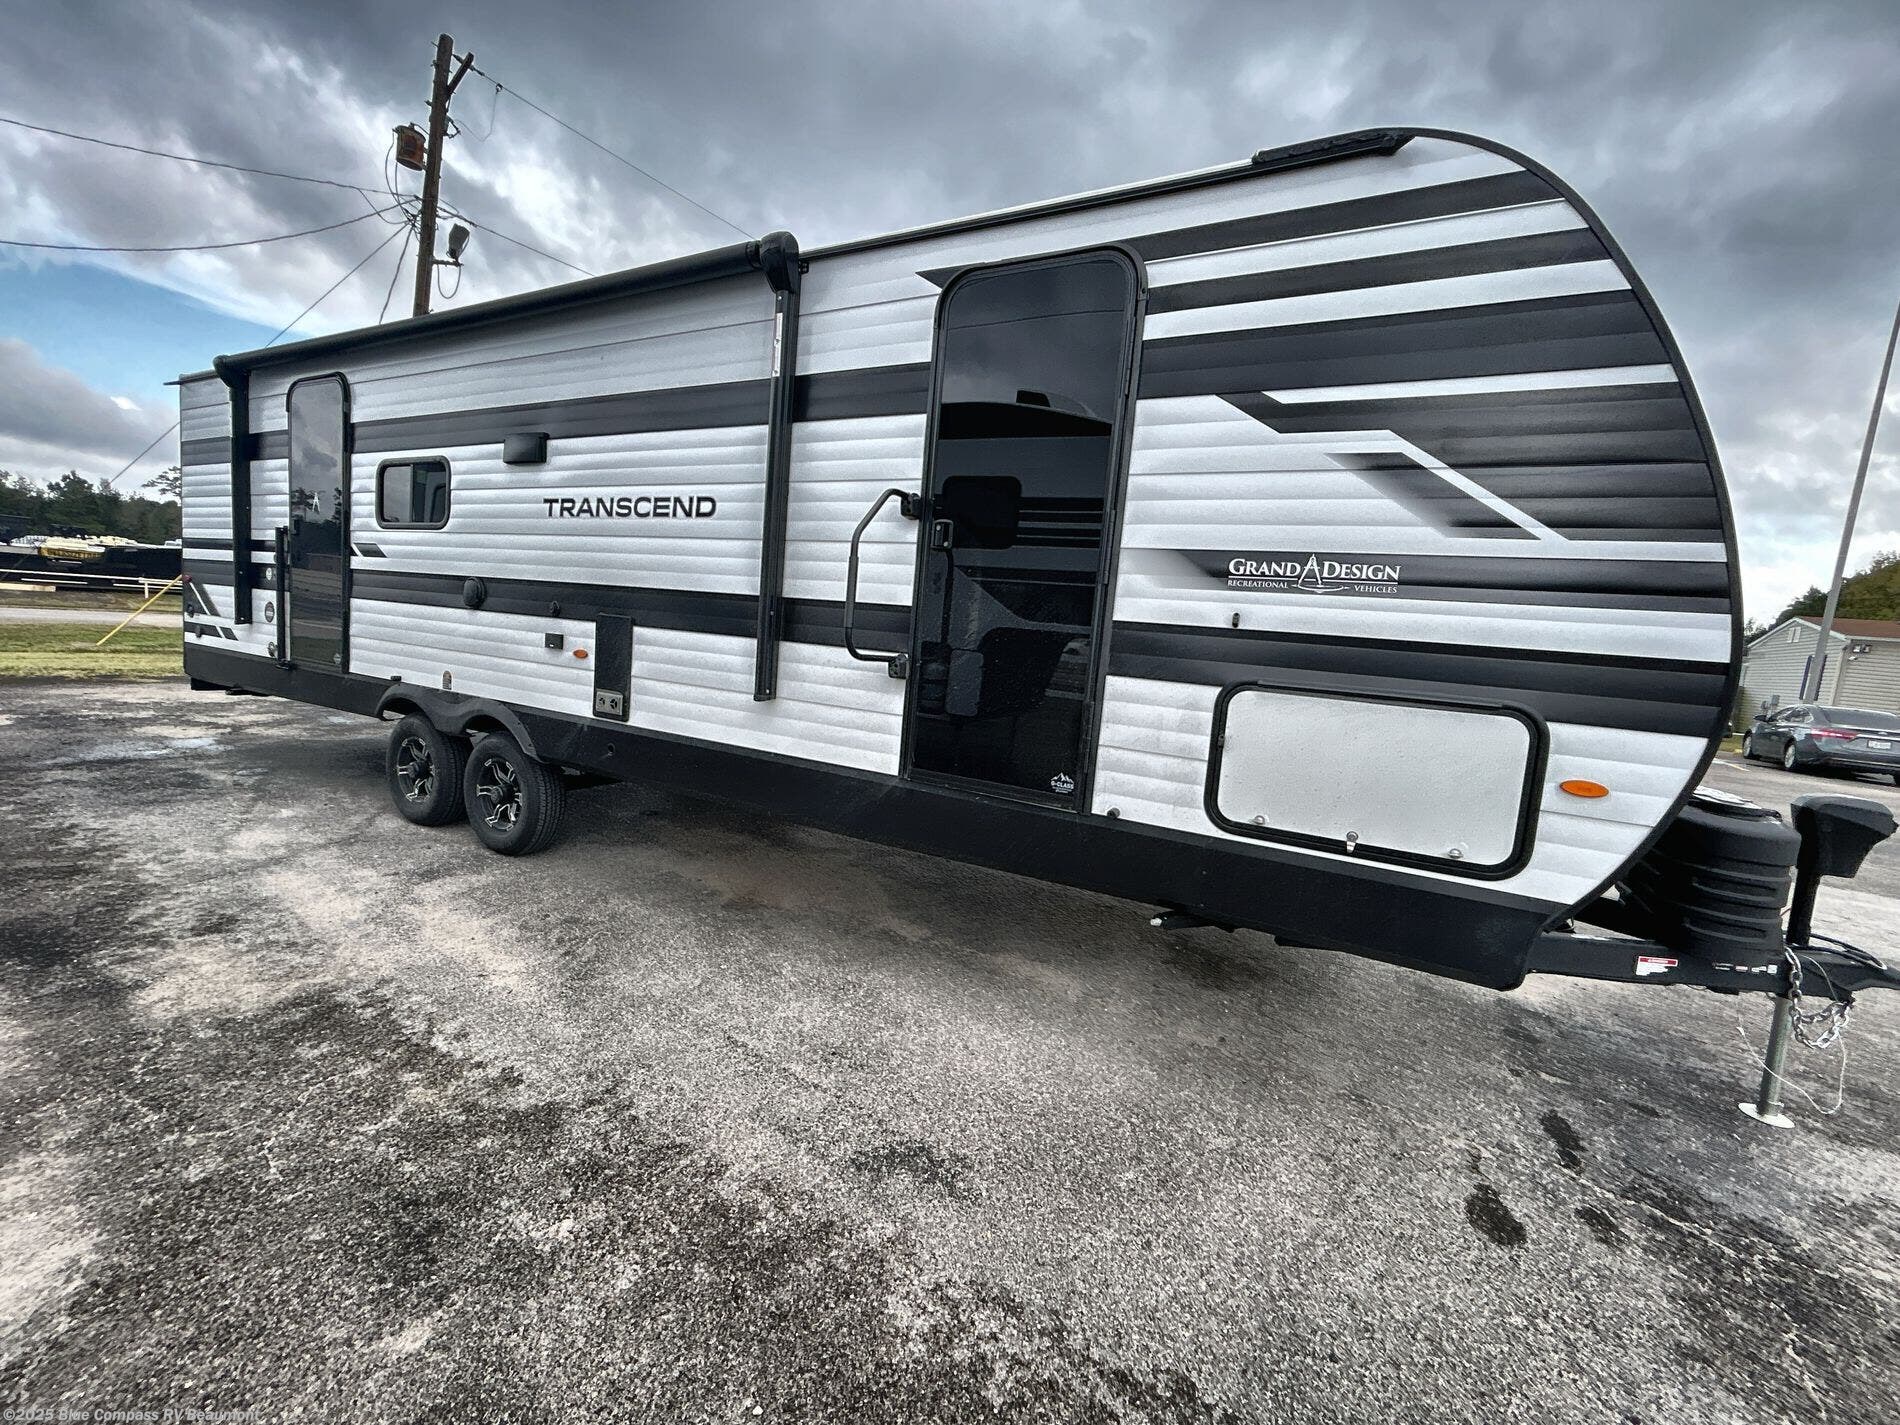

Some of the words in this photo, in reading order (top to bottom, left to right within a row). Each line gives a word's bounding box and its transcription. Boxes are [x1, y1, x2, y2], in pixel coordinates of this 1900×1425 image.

[543, 496, 717, 518] TRANSCEND
[1228, 558, 1300, 576] GRAND
[1322, 560, 1402, 581] DESIGN
[1227, 579, 1289, 589] RECREATIONAL
[1354, 584, 1398, 594] VEHICLES
